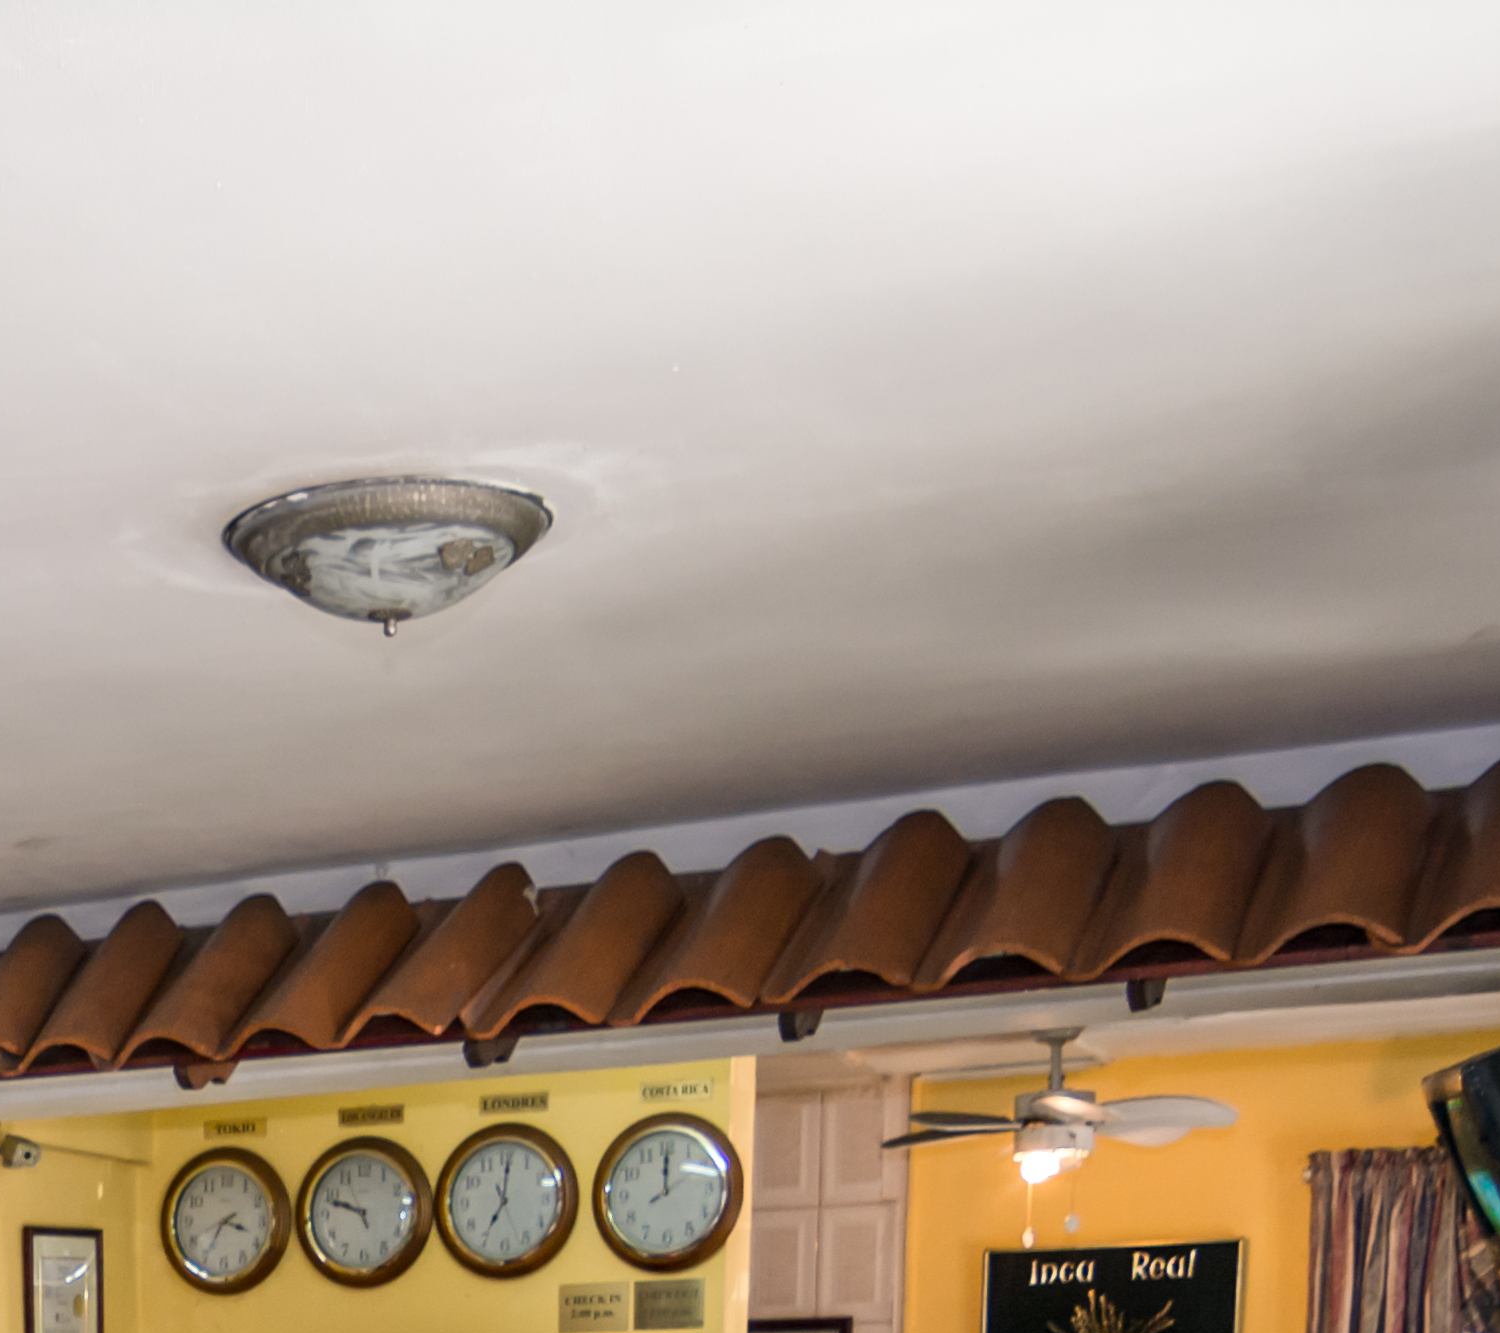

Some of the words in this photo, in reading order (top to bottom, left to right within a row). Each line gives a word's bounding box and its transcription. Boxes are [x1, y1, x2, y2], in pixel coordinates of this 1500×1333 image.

[642, 1084, 678, 1099] COSTA
[681, 1081, 709, 1095] RICA
[482, 1095, 548, 1111] LONDRES
[215, 1122, 257, 1135] TOKIO
[1028, 1259, 1096, 1287] Inca
[1132, 1248, 1198, 1281] Real
[564, 1294, 606, 1306] CHECK
[609, 1294, 621, 1304] IN
